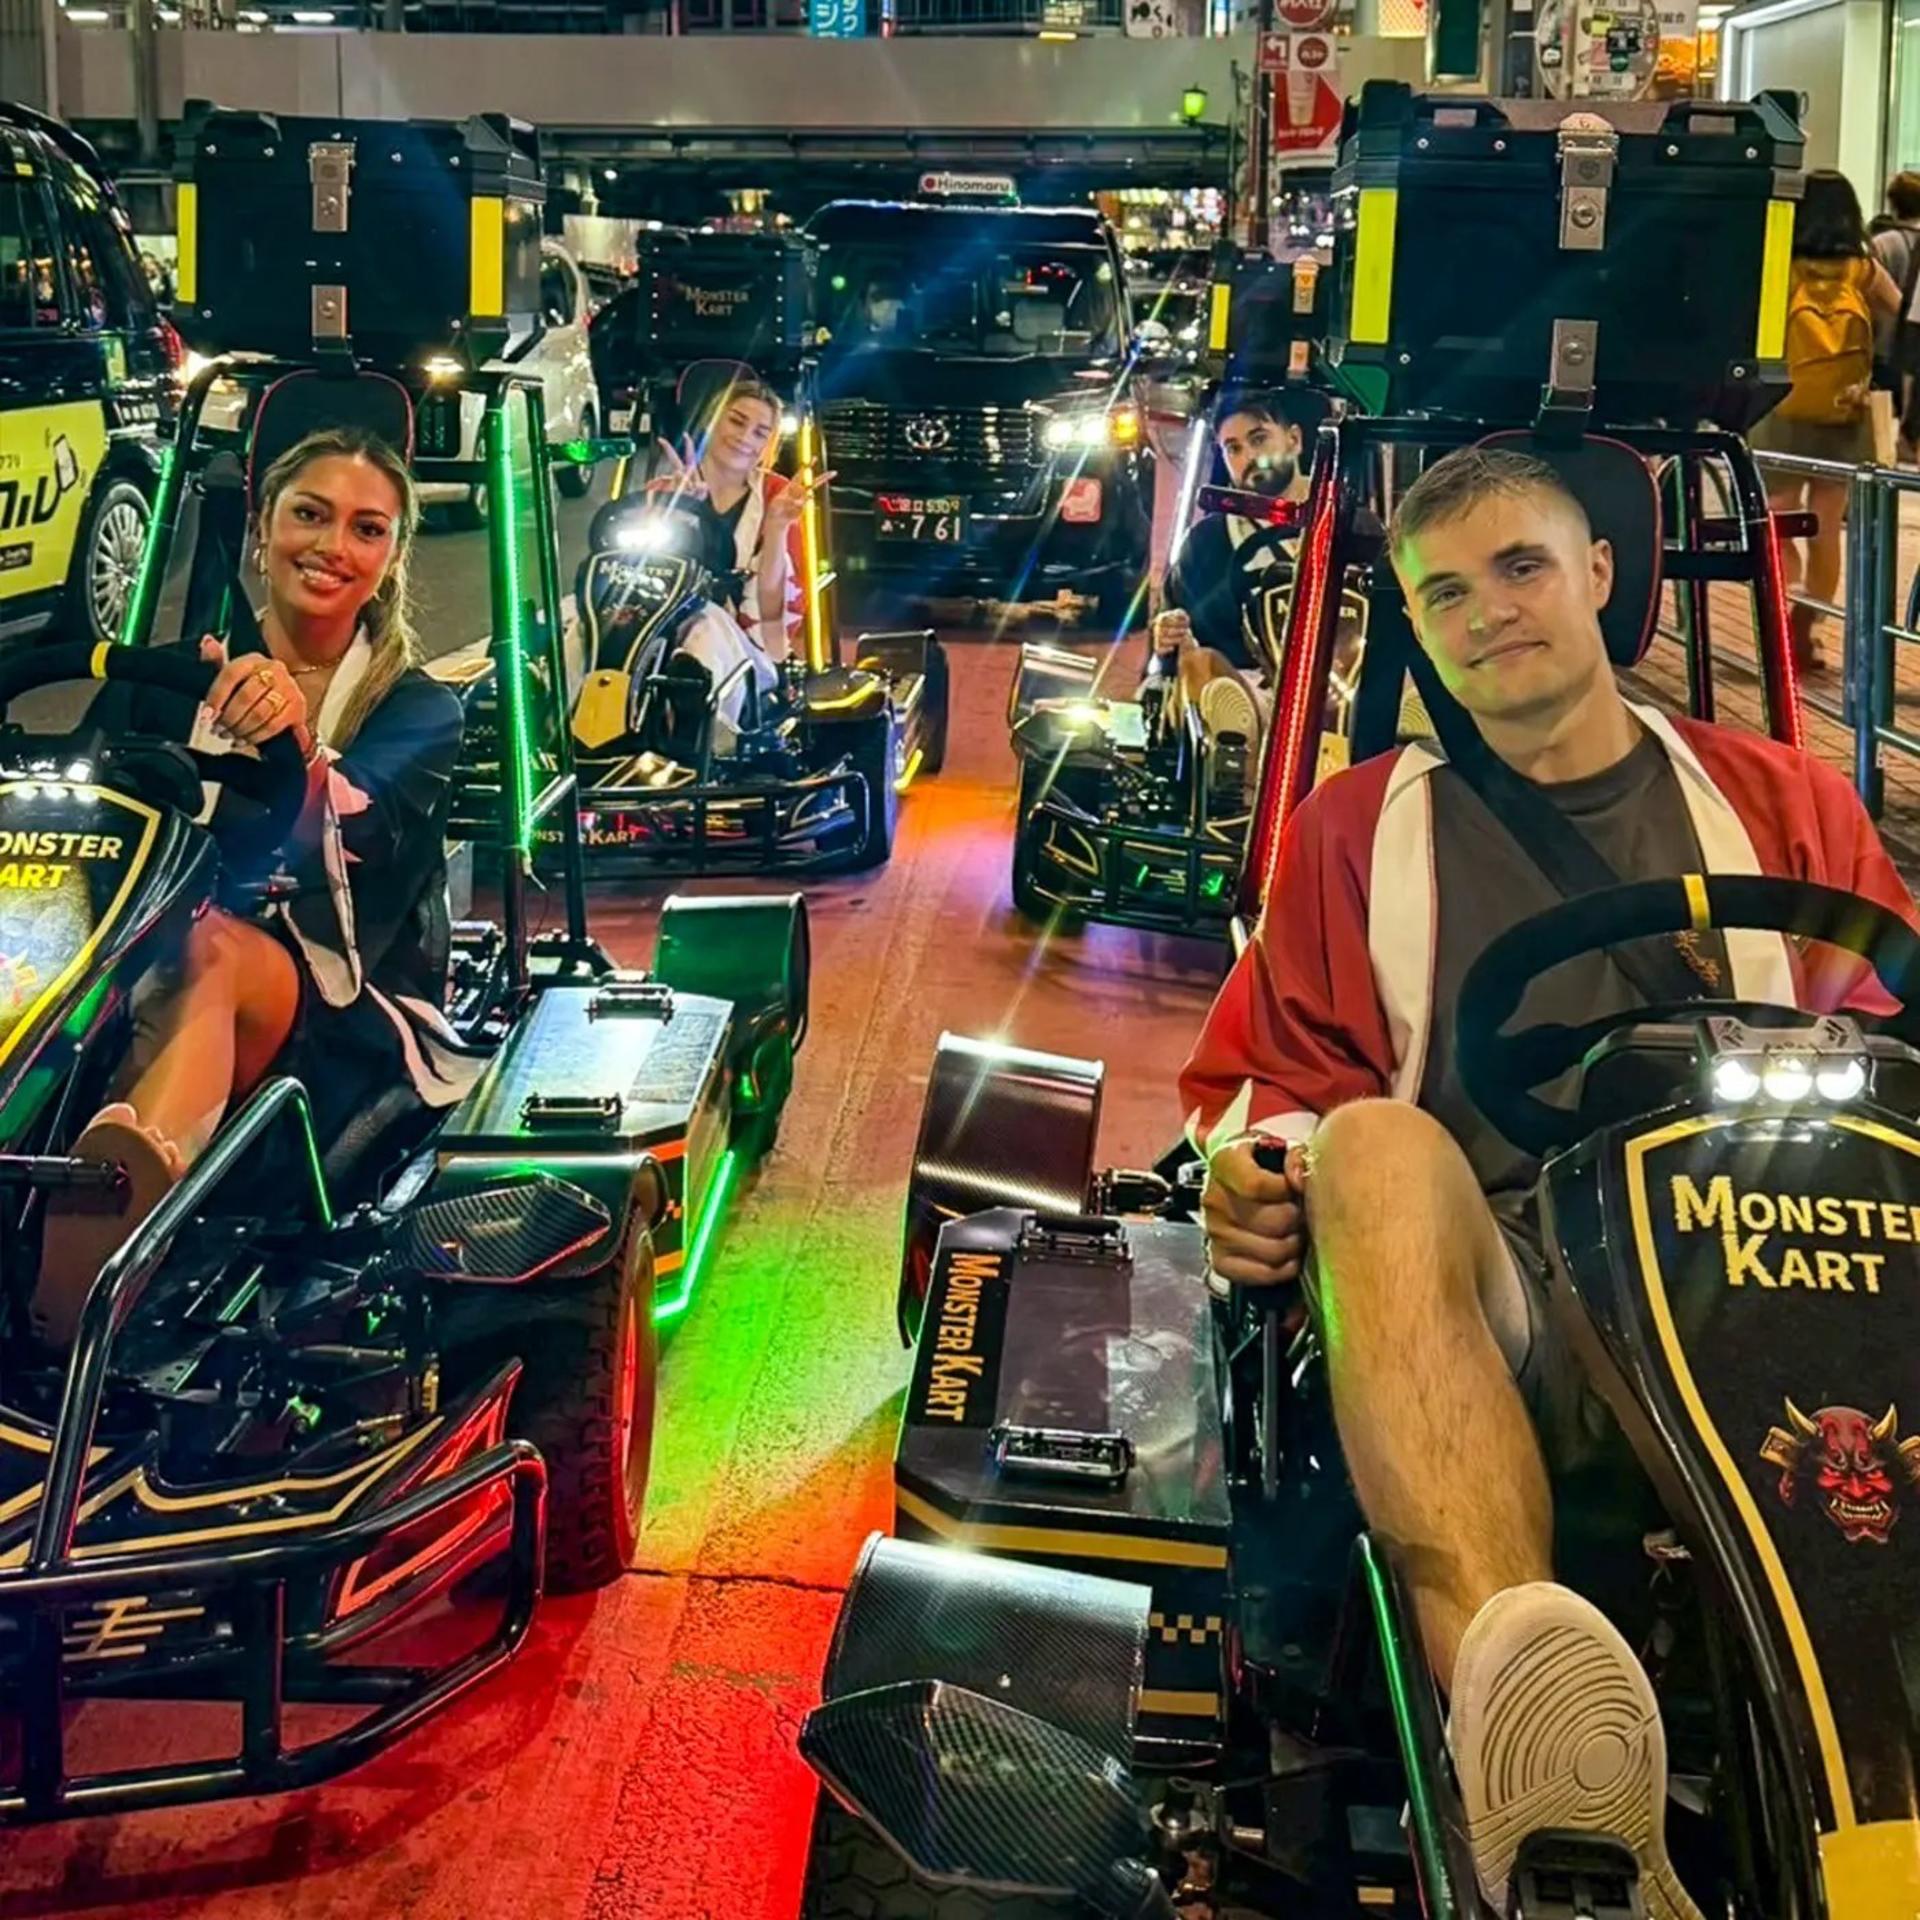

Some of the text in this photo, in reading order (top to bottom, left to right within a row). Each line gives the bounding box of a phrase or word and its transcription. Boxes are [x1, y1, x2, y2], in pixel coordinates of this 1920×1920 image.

[938, 177, 1009, 191] Hinomaru
[685, 286, 749, 302] MONSTER
[695, 300, 733, 316] KART
[0, 831, 123, 858] ONSTER
[588, 828, 639, 845] KART
[0, 863, 71, 888] ART
[1722, 1232, 1885, 1293] KART
[925, 1252, 1002, 1421] MONSTER KART
